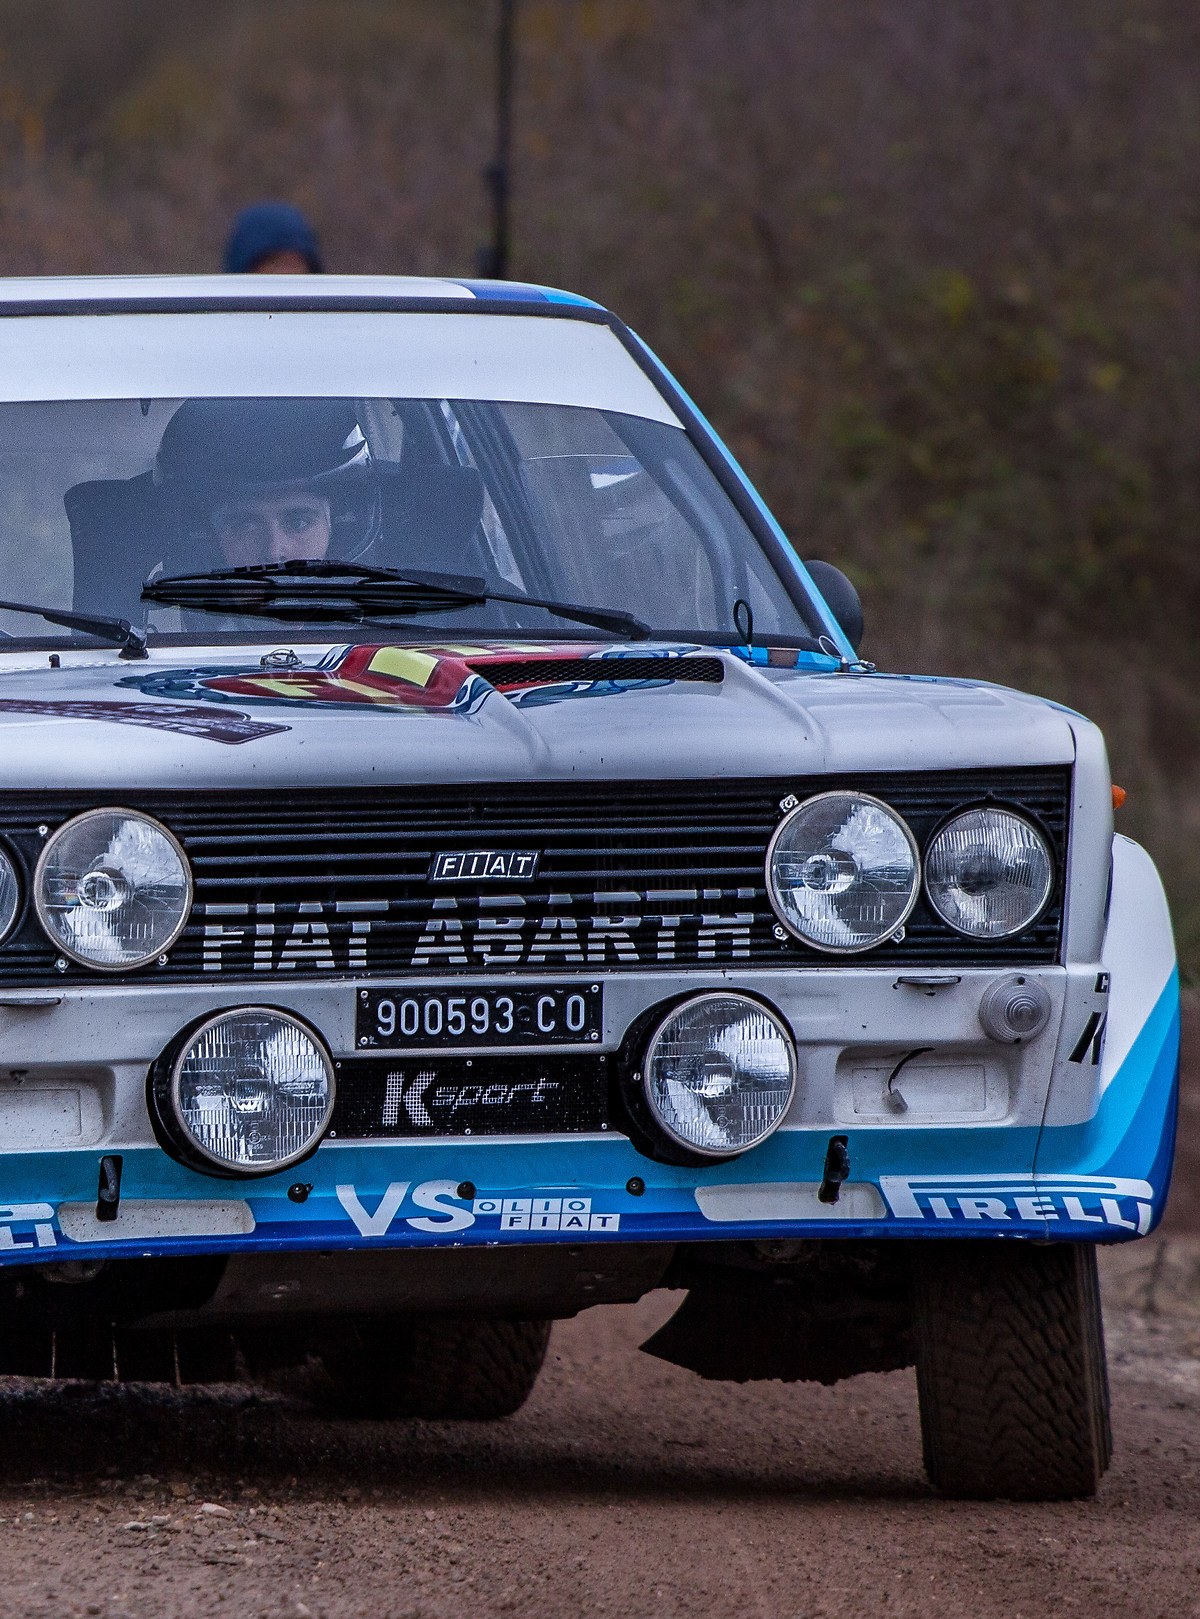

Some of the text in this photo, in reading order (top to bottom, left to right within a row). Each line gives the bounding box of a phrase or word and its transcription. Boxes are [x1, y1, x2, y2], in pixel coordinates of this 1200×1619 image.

[441, 853, 536, 876] FIAT
[203, 887, 756, 971] FIAT ABARTH
[377, 996, 514, 1036] 900593
[335, 1179, 586, 1237] VS OLIO
[508, 1215, 613, 1228] FIAT
[879, 1172, 1153, 1236] PIRELLI
